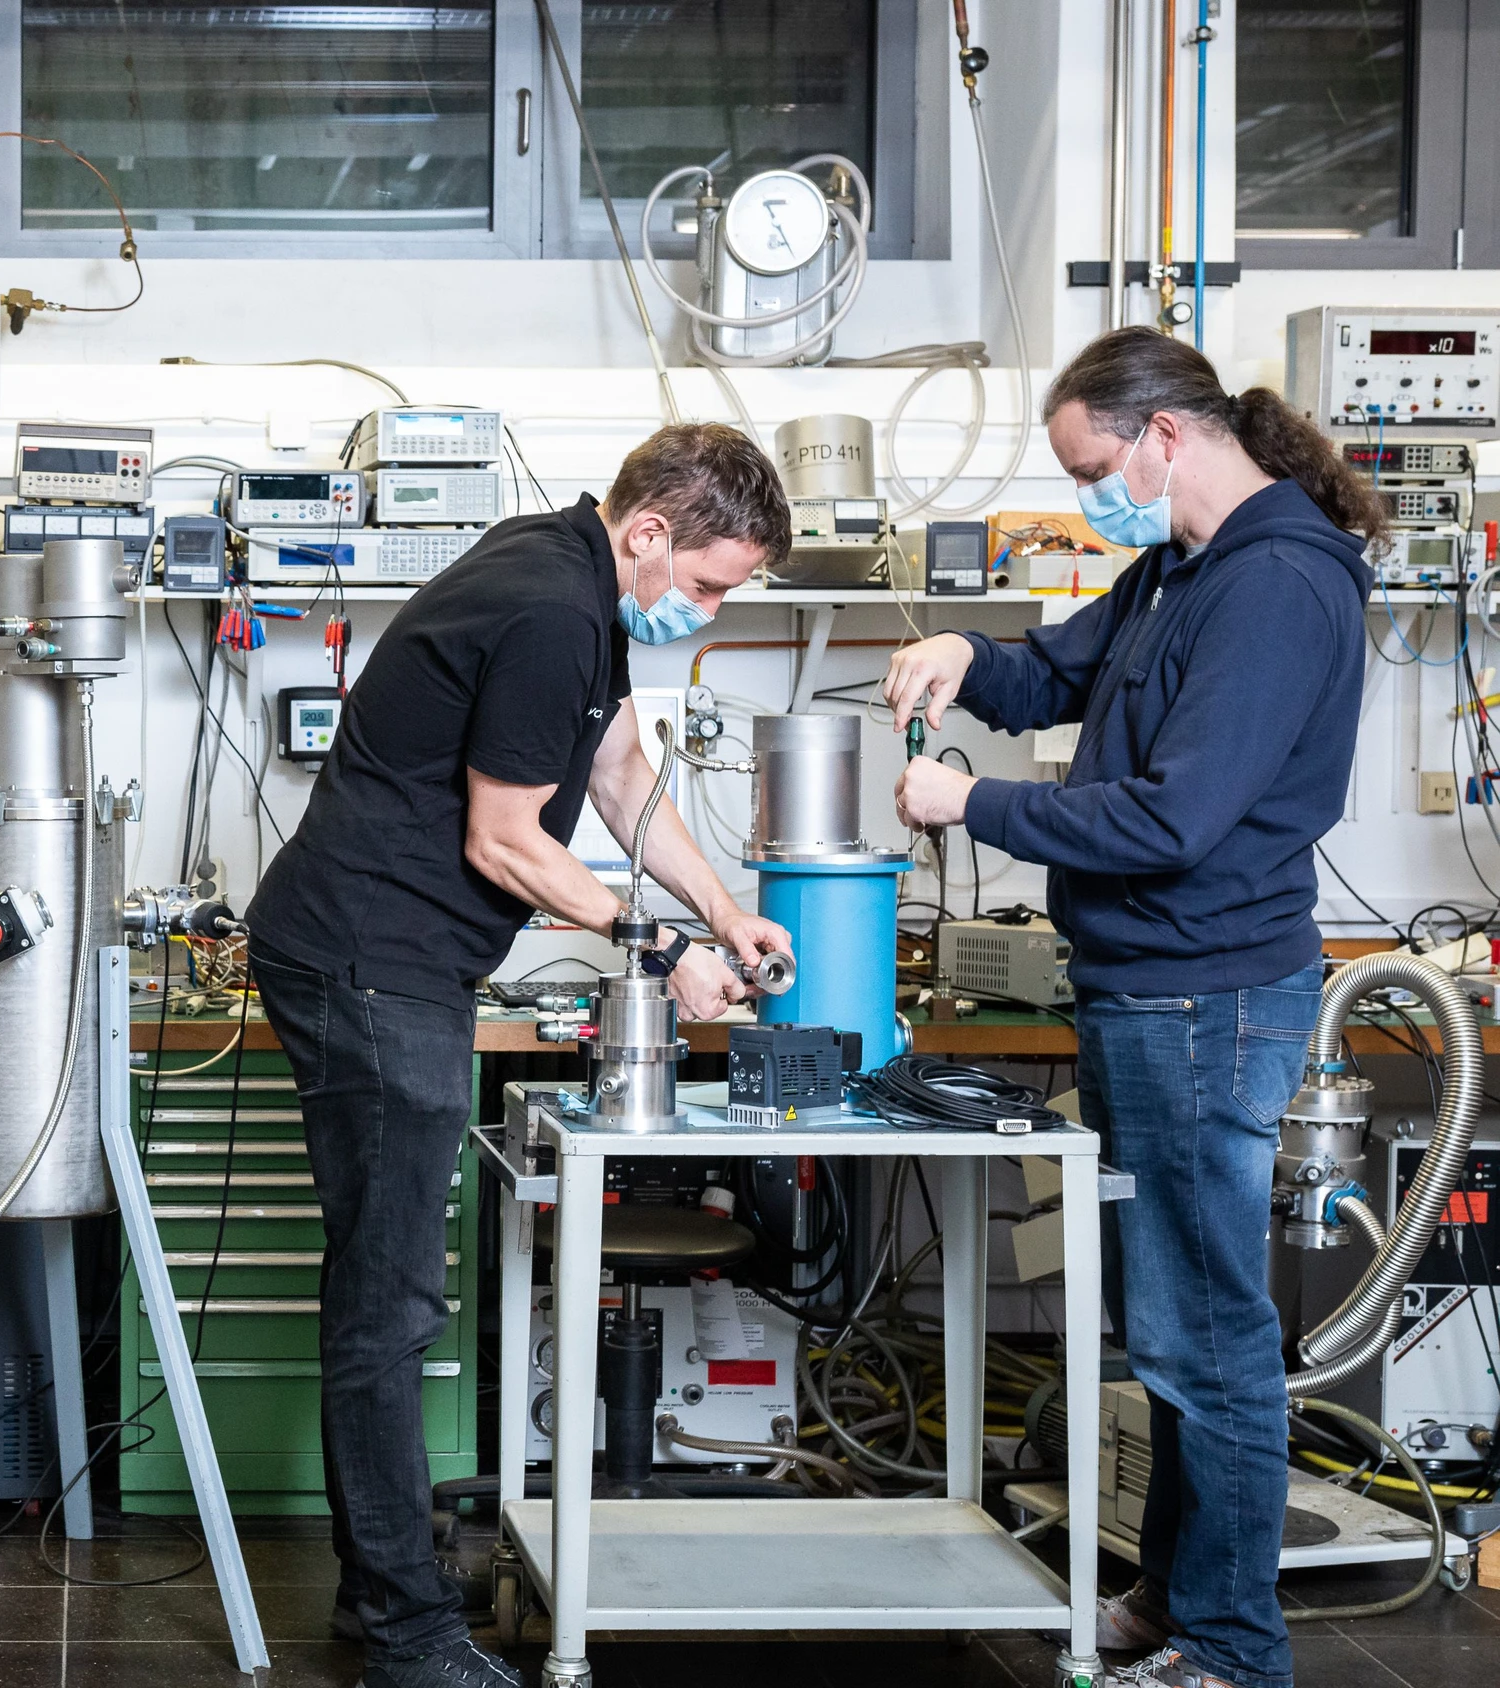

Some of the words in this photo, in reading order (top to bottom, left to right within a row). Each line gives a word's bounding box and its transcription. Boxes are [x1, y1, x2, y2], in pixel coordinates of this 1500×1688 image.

[1429, 337, 1454, 353] x10
[1479, 333, 1488, 342] W
[799, 444, 832, 463] PTD
[837, 444, 861, 461] 411
[1394, 1310, 1440, 1352] COOLPAK
[1441, 1288, 1464, 1310] 6000
